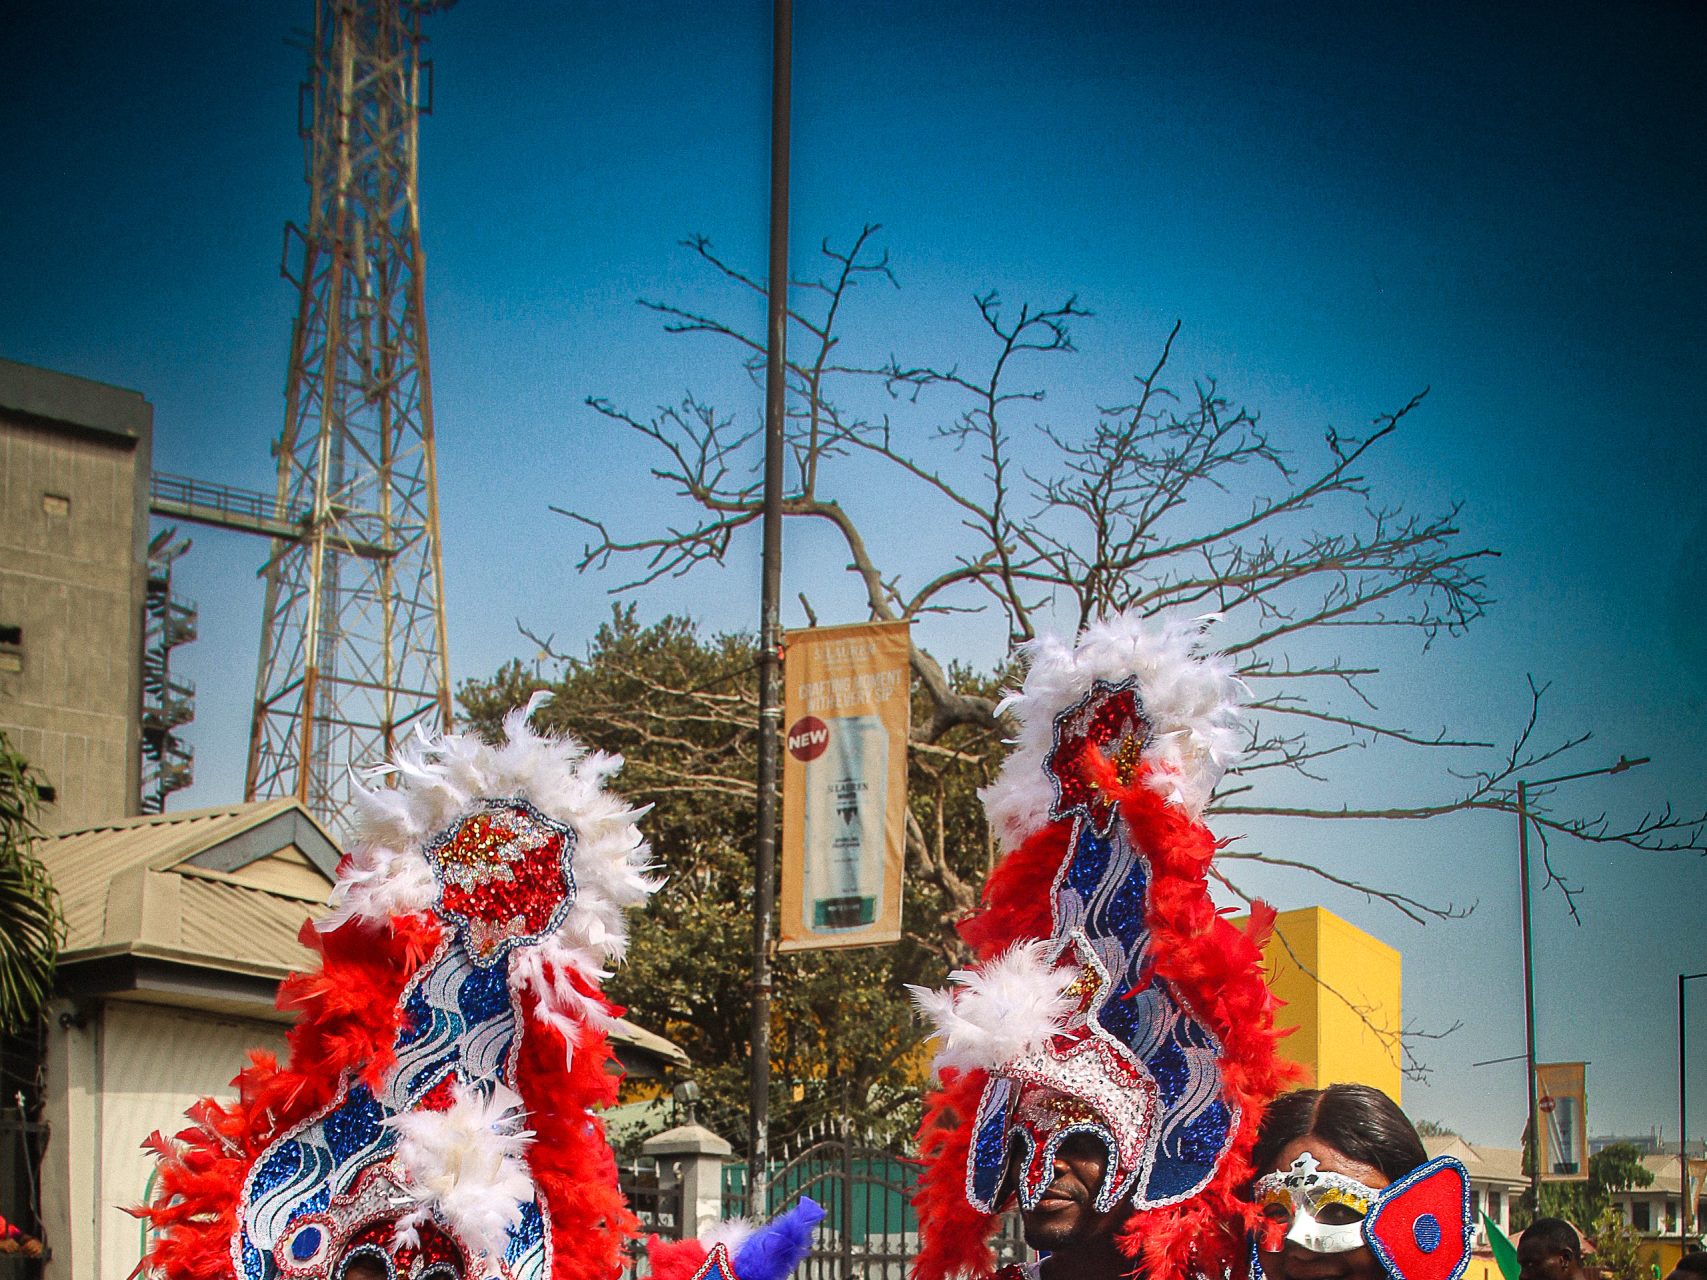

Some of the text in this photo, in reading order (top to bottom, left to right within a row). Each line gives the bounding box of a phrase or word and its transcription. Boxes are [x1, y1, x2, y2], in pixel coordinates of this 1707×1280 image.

[855, 669, 902, 690] MOMENT
[808, 687, 893, 712] WITH EVERY SIP
[789, 728, 827, 750] NEW
